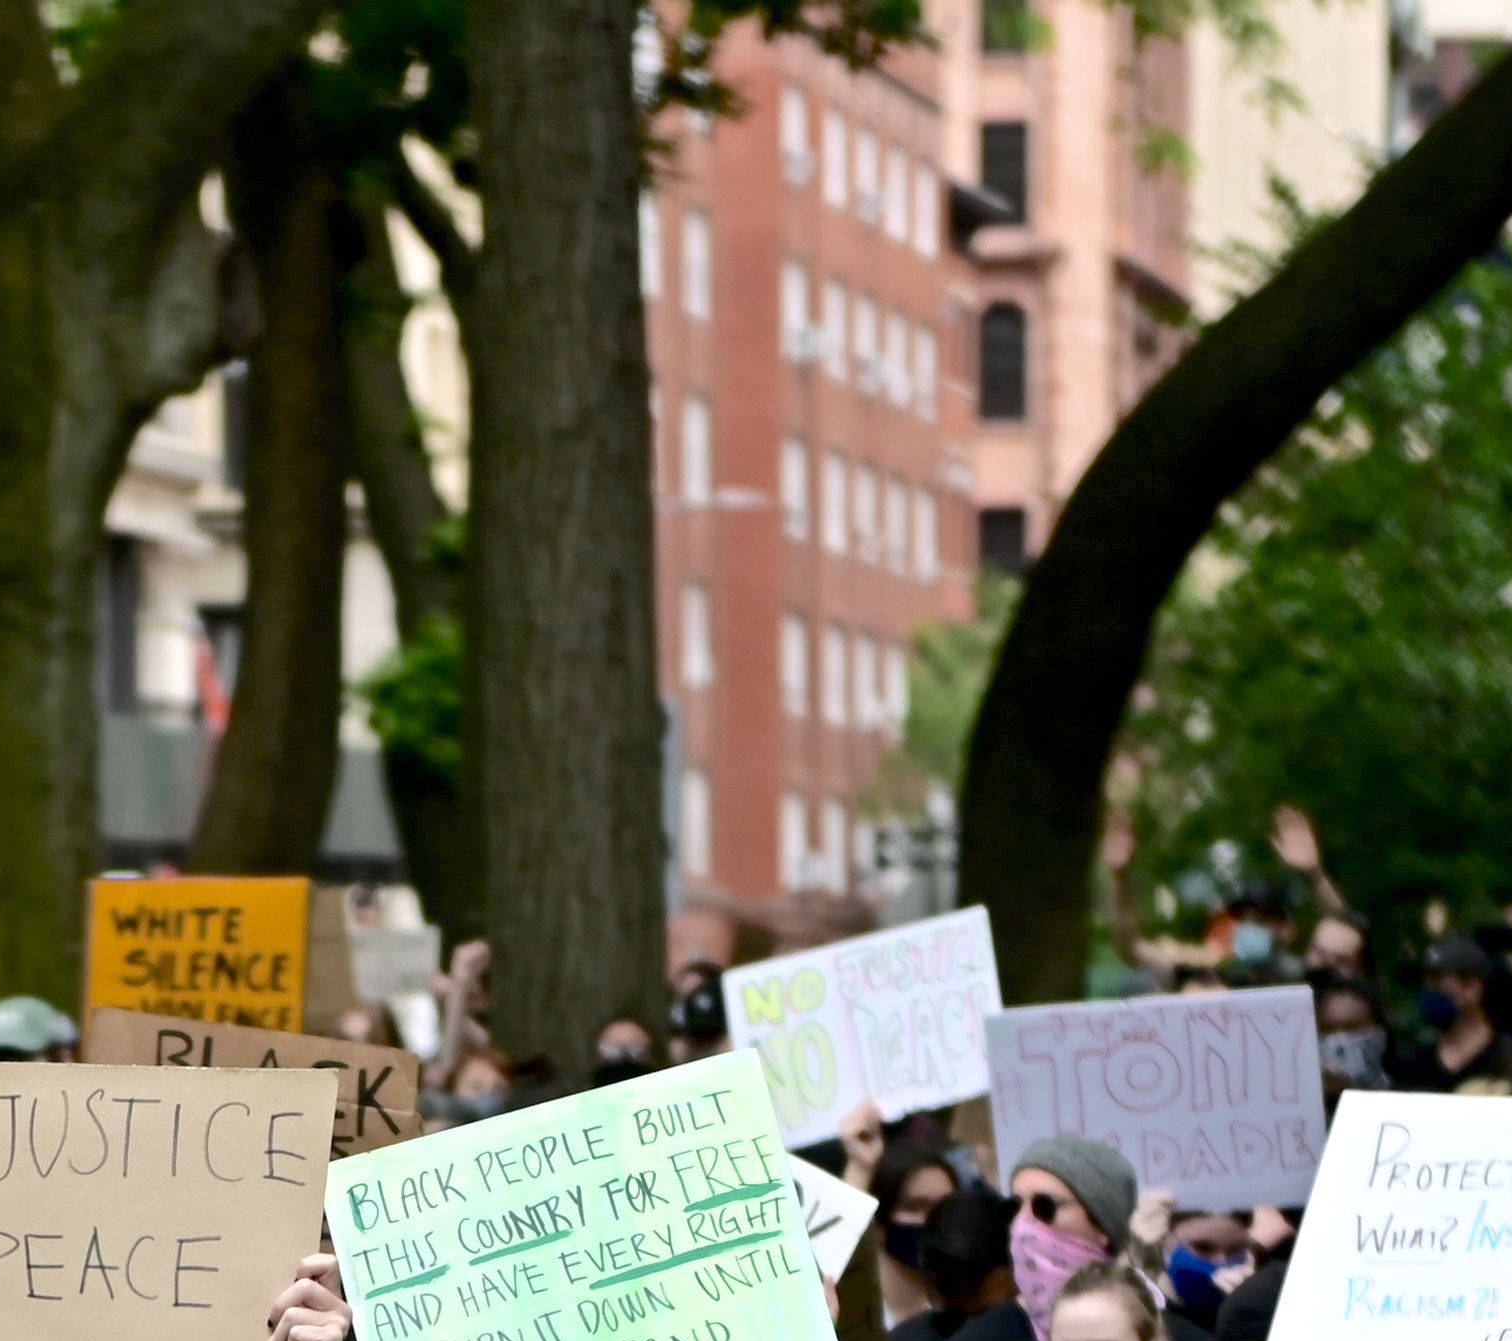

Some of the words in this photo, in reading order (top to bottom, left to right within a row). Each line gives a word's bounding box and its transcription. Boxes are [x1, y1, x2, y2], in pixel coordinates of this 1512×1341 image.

[109, 905, 245, 943] WHITE
[120, 949, 290, 993] SILENCE
[742, 965, 826, 1026] NO
[346, 1162, 467, 1234] BLACK
[475, 1124, 616, 1193] PEOPLE
[632, 1089, 733, 1147] BUILT
[352, 1231, 440, 1288] THIS
[456, 1186, 589, 1256] COUNTRY
[605, 1170, 671, 1220] FOR
[667, 1133, 784, 1205] FREE
[1355, 1213, 1459, 1255] WHAT?
[461, 1261, 550, 1319] HAVE
[561, 1223, 676, 1287] EVERY
[686, 1195, 788, 1246] RIGHT
[577, 1286, 675, 1336] DOWN
[694, 1243, 802, 1303] UNTIL
